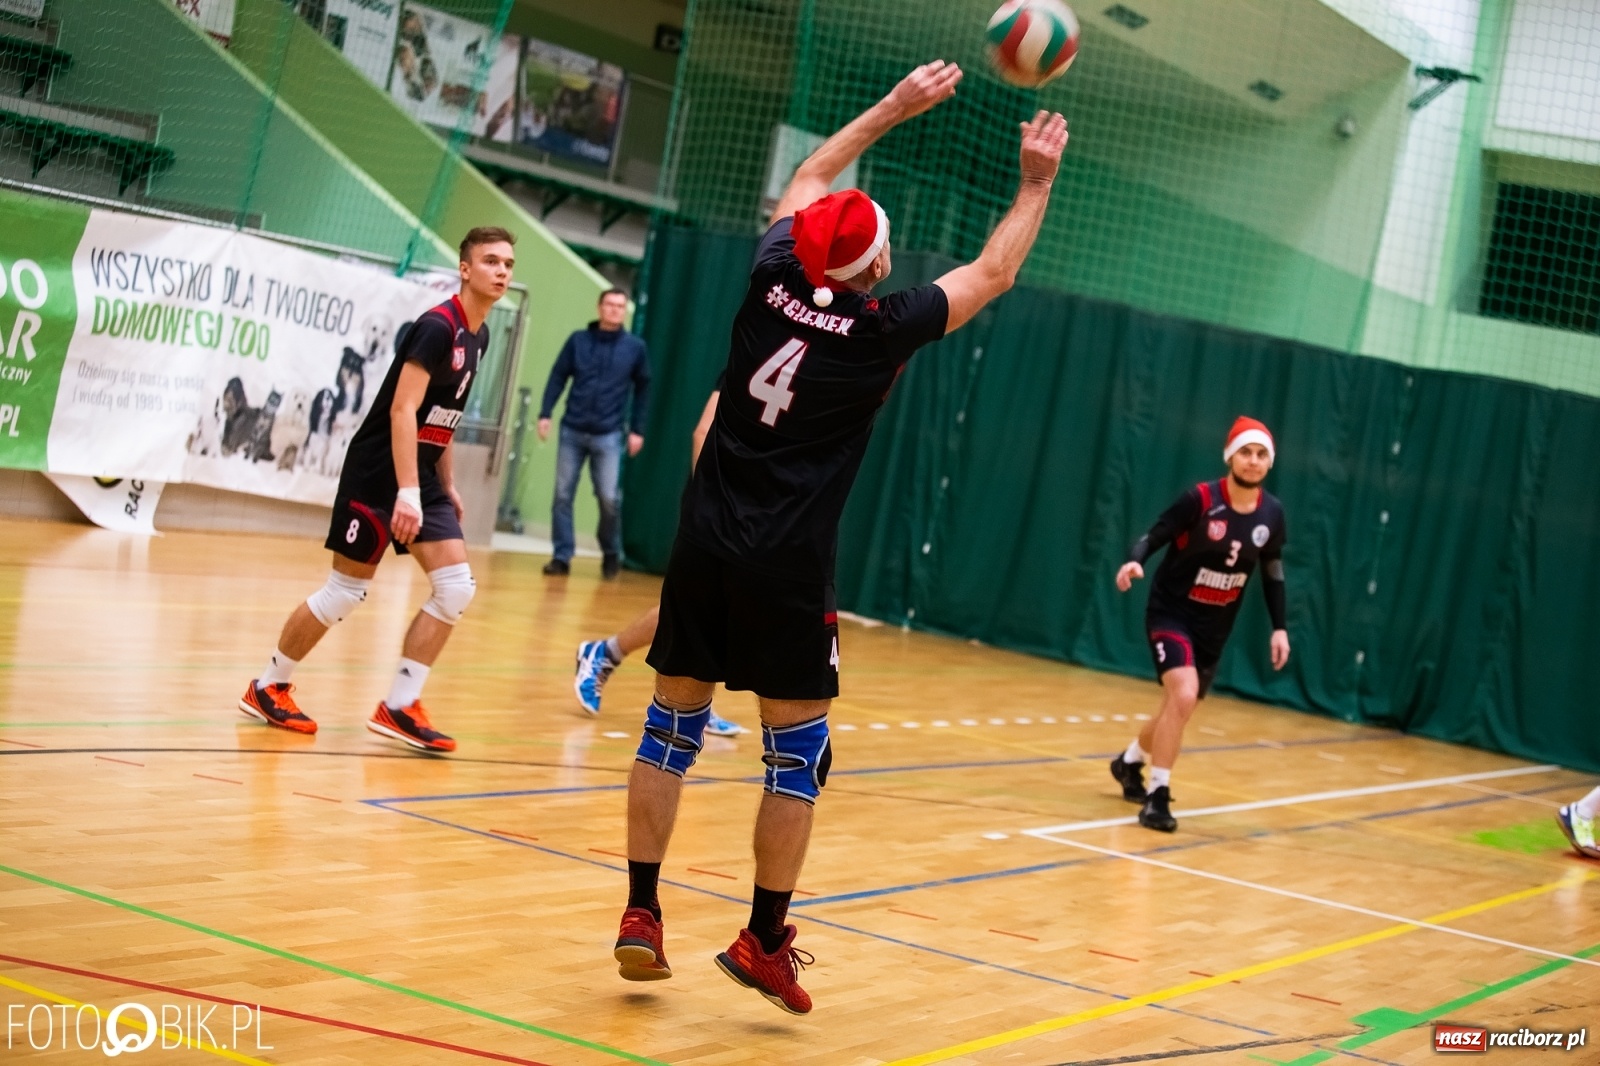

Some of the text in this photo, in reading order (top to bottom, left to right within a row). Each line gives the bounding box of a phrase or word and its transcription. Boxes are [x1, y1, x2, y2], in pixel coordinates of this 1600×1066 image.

[0, 258, 48, 310] O
[91, 246, 355, 337] WSZYSTKO DLA TWOJEGO
[0, 309, 42, 363] R
[228, 316, 270, 362] ZOO
[117, 392, 130, 409] od
[455, 370, 471, 400] 8
[749, 337, 808, 427] 4
[346, 518, 360, 544] 8
[1225, 540, 1242, 567] 3
[829, 636, 840, 672] 4
